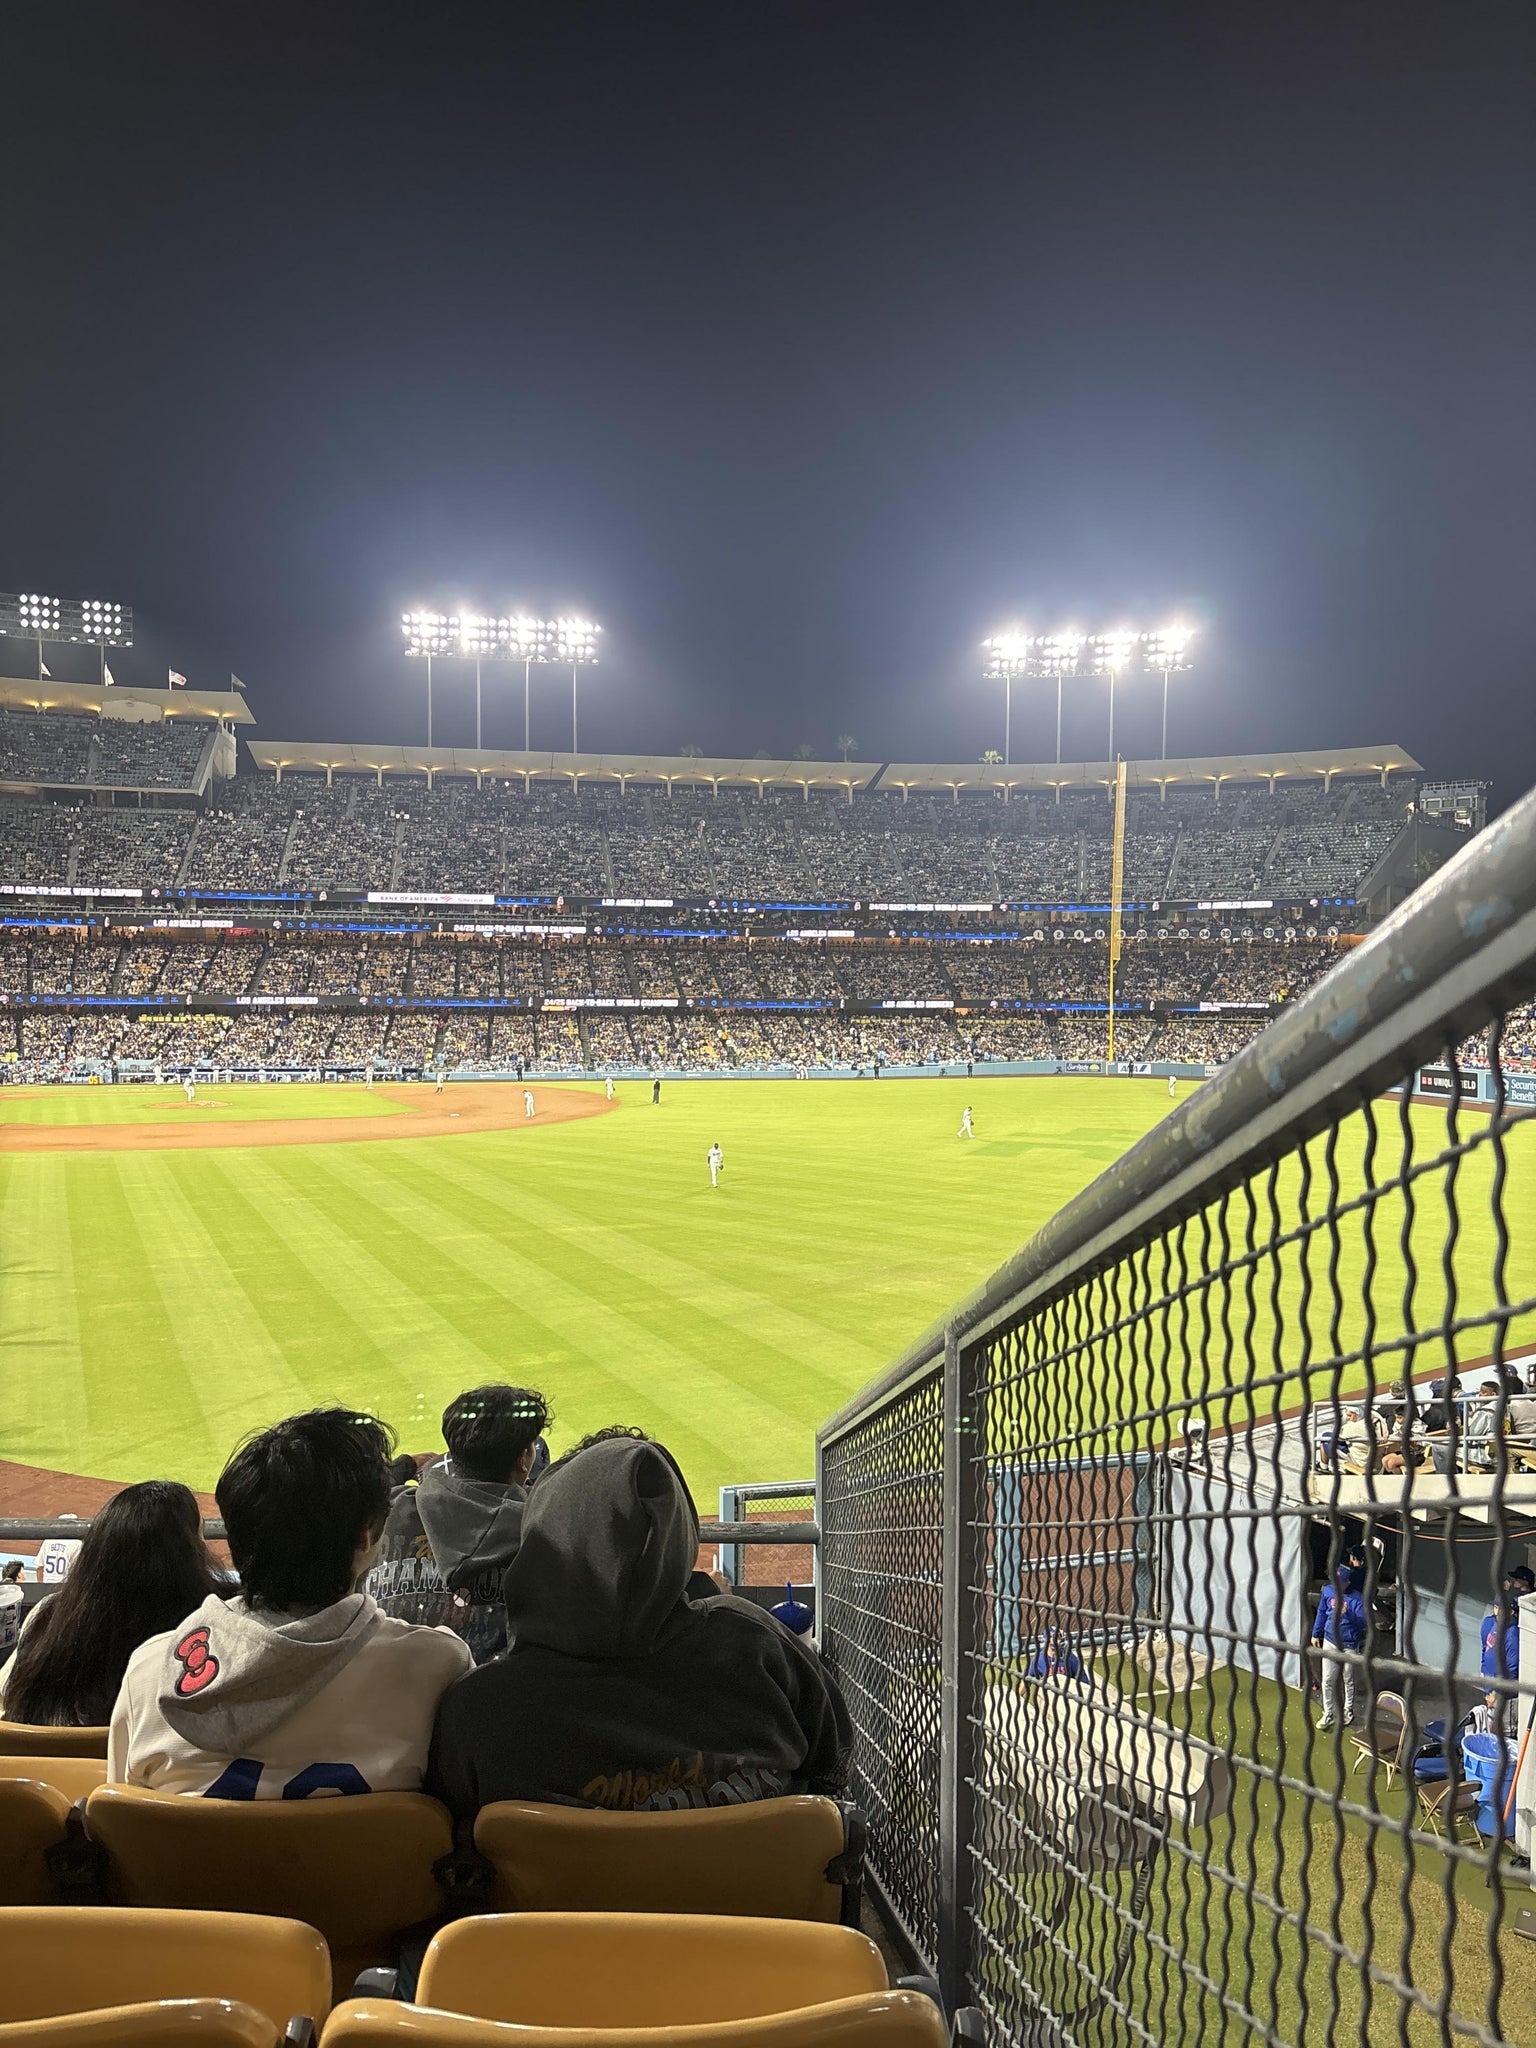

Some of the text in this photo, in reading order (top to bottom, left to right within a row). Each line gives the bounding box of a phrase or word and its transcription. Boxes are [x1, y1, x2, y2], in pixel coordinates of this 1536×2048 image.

[153, 919, 167, 927] LOS
[169, 919, 201, 928] ANGELES
[453, 924, 474, 932] 24/25
[475, 924, 524, 933] BACK-TO-BACK
[525, 925, 548, 933] WORLD
[786, 929, 799, 937] LOS
[236, 996, 251, 1004] LOS
[252, 996, 284, 1004] ANGELES
[565, 999, 615, 1007] BACK-TO-BACK
[616, 999, 640, 1007] WORLD
[882, 1000, 895, 1008] LOS
[1511, 1089, 1535, 1102] Benefit
[50, 1543, 66, 1553] BETTS
[45, 1555, 66, 1575] 50
